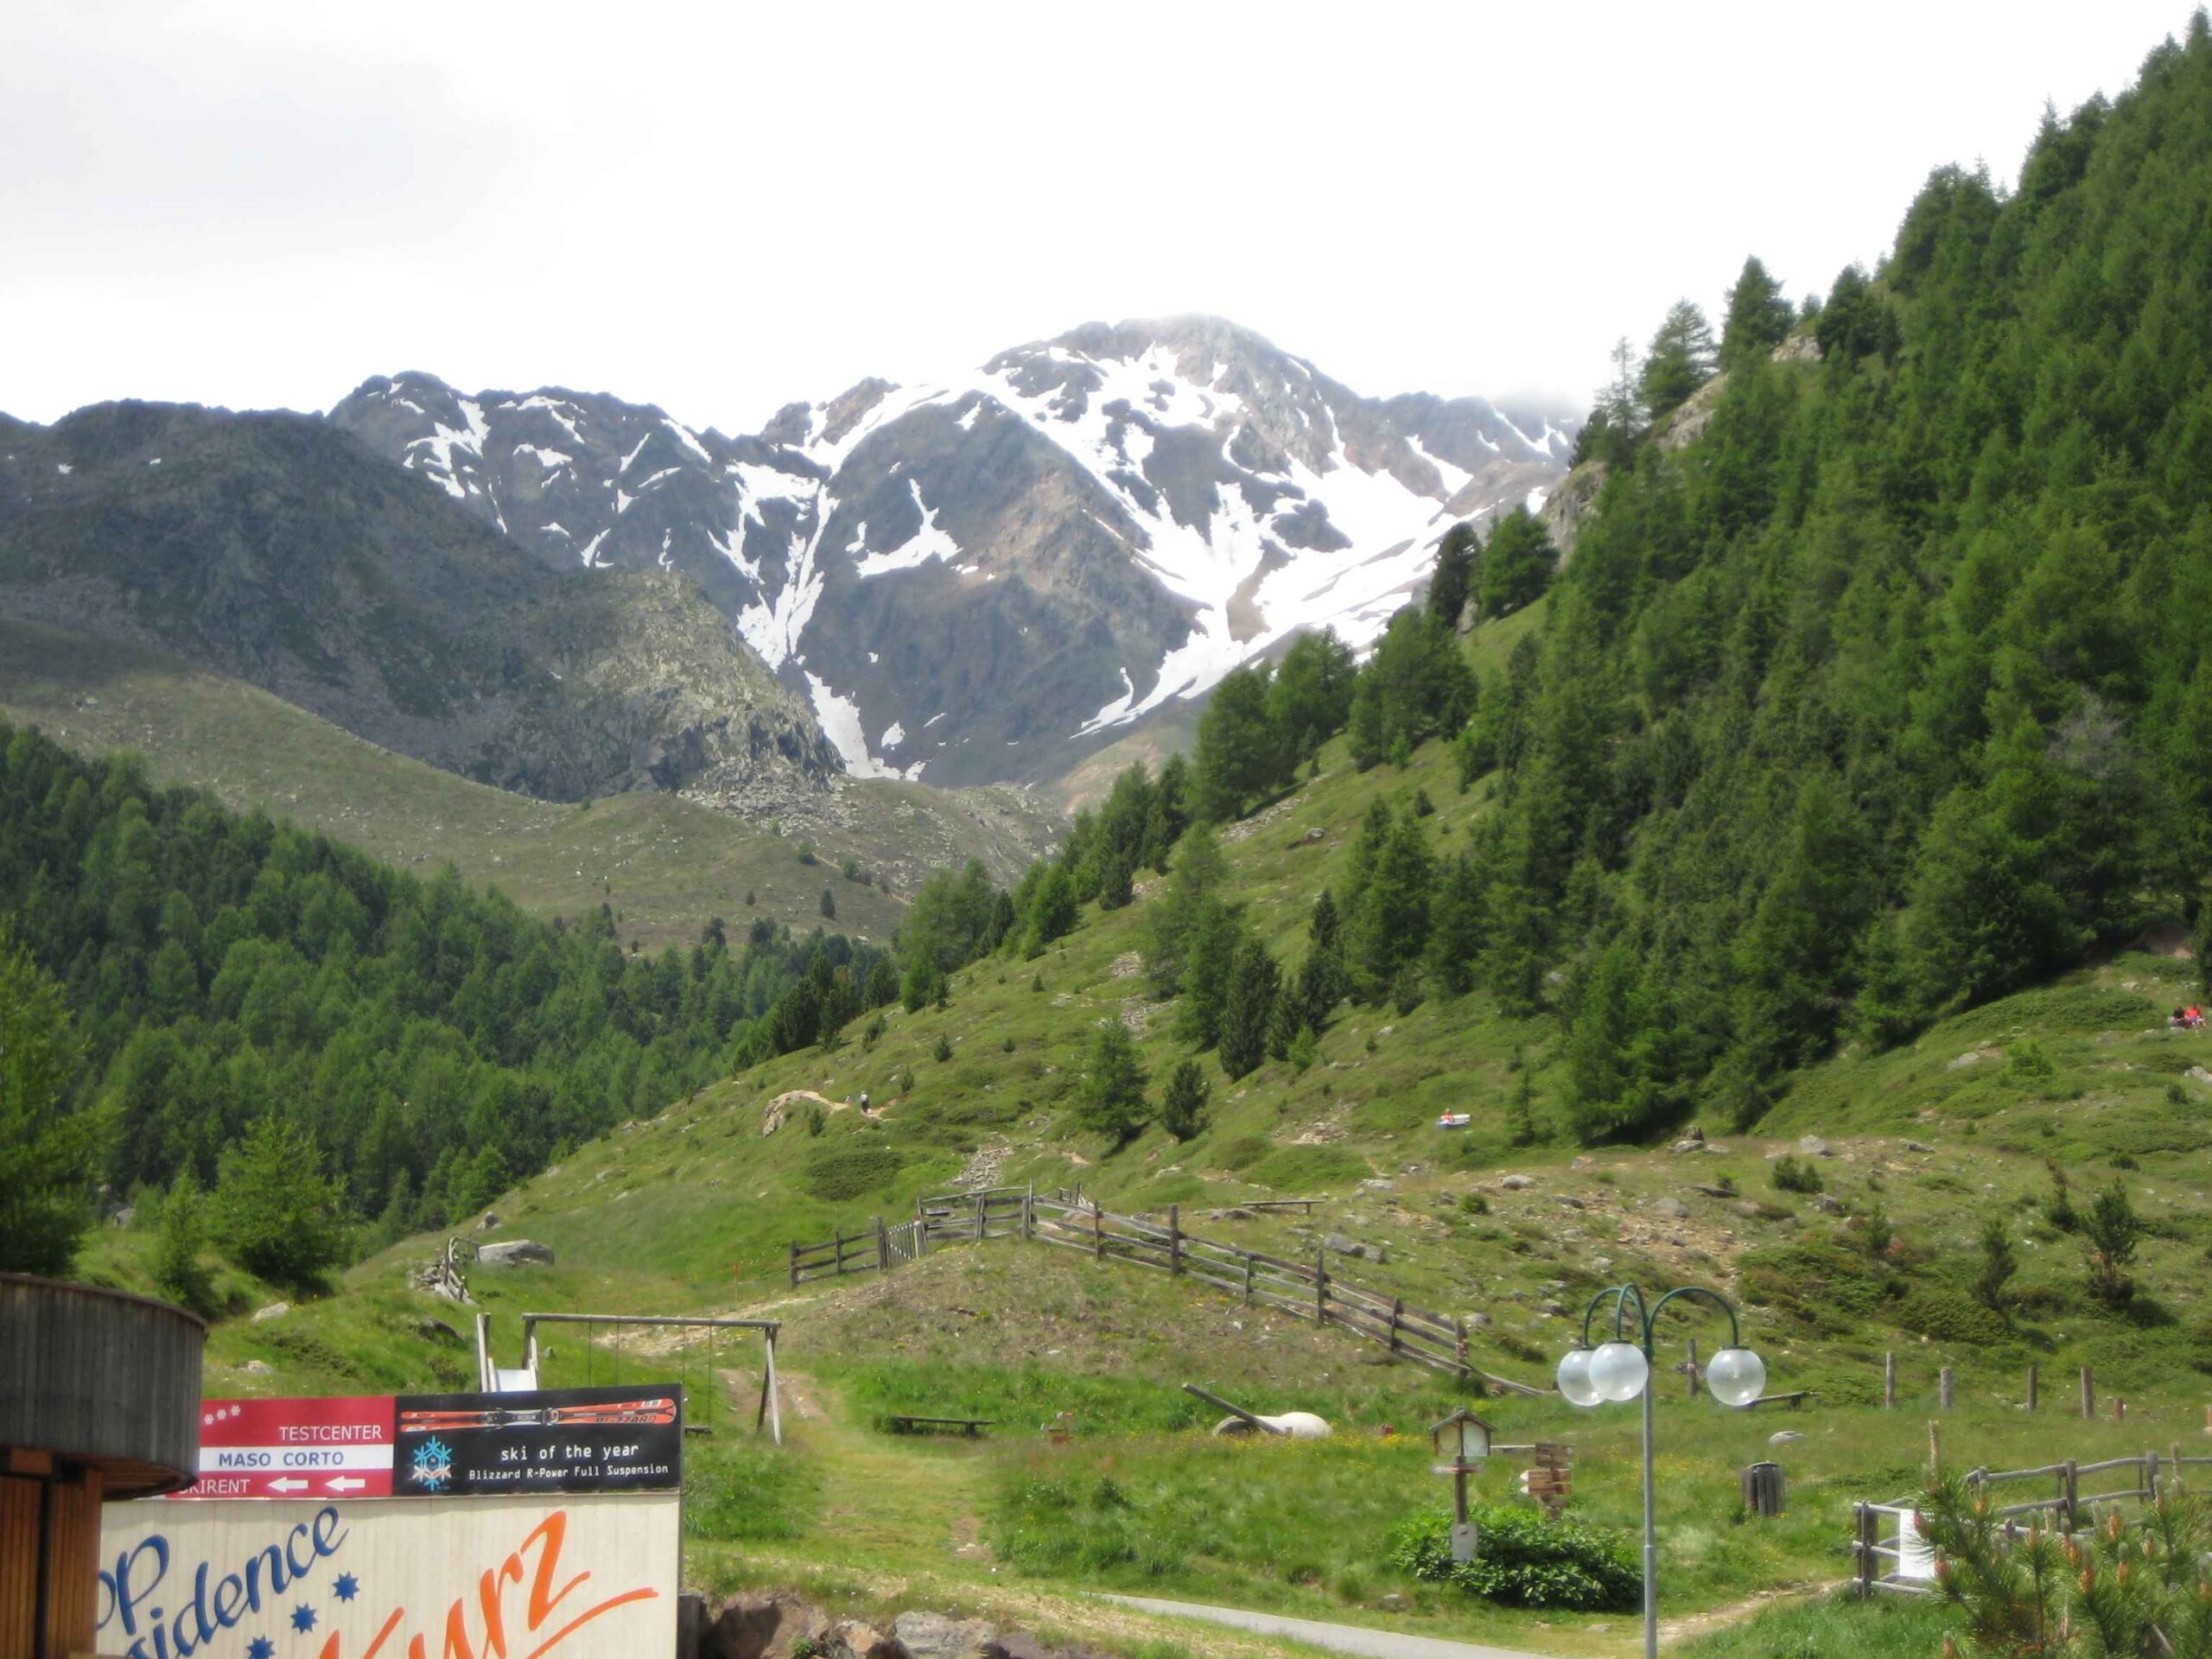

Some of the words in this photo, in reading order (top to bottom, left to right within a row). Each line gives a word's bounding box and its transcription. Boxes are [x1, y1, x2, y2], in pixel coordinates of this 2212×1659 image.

[279, 1425, 383, 1441] TESTCENTER
[219, 1452, 271, 1467] MASO
[283, 1452, 344, 1466] CORTO
[501, 1446, 528, 1461] ski
[539, 1446, 556, 1460] of
[566, 1445, 592, 1458] the
[603, 1444, 639, 1460] year
[469, 1470, 520, 1480] Blizzard
[526, 1469, 569, 1478] R-Power
[575, 1466, 599, 1476] Full
[607, 1465, 669, 1477] Suspension
